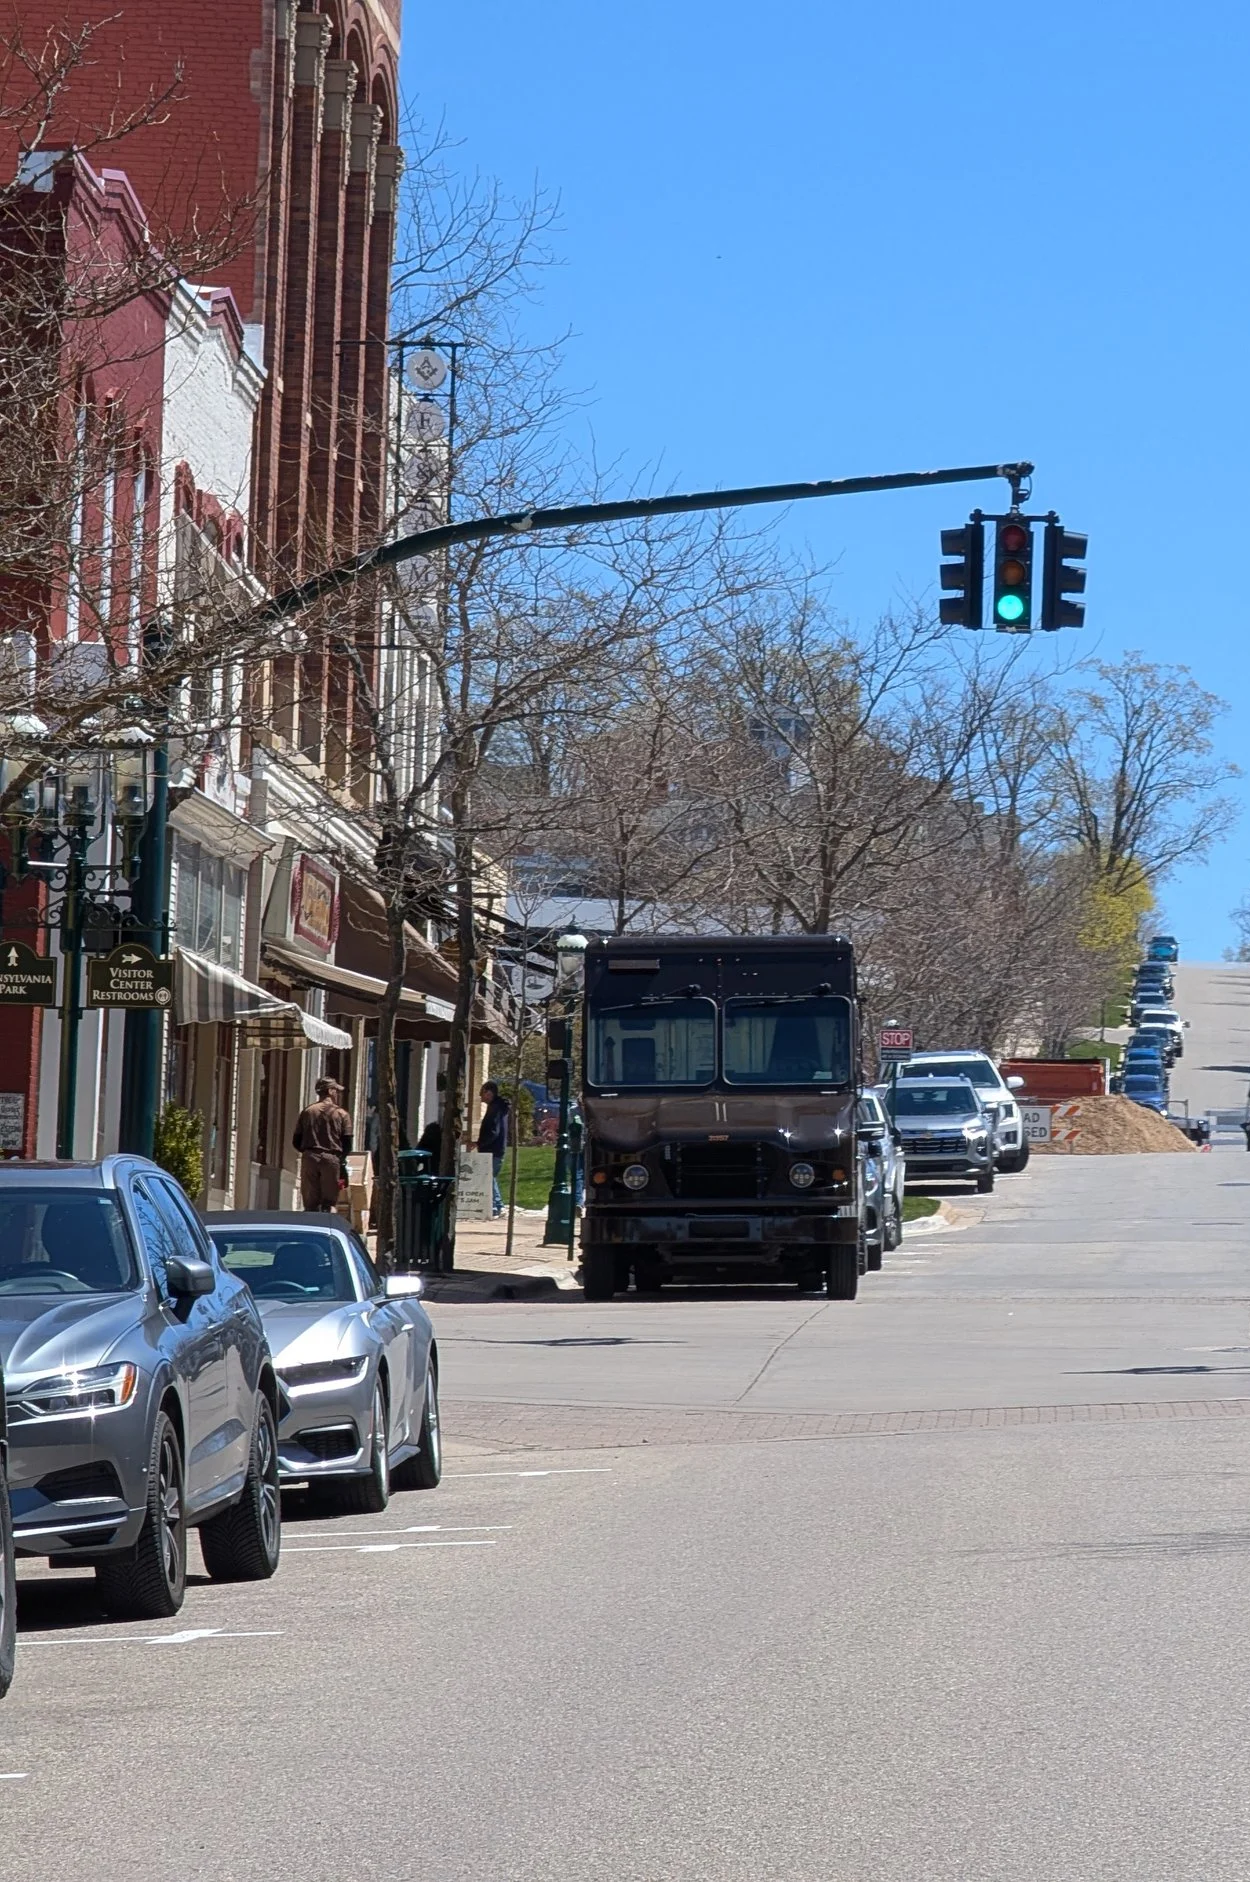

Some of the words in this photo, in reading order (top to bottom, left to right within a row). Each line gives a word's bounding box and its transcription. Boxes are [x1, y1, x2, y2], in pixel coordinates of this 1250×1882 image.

[109, 967, 154, 978] VISITOR
[0, 983, 28, 994] PARK
[110, 978, 153, 990] CENTER
[92, 989, 154, 1001] RESTROOMS
[882, 1032, 911, 1045] STOP
[1023, 1112, 1041, 1123] AD
